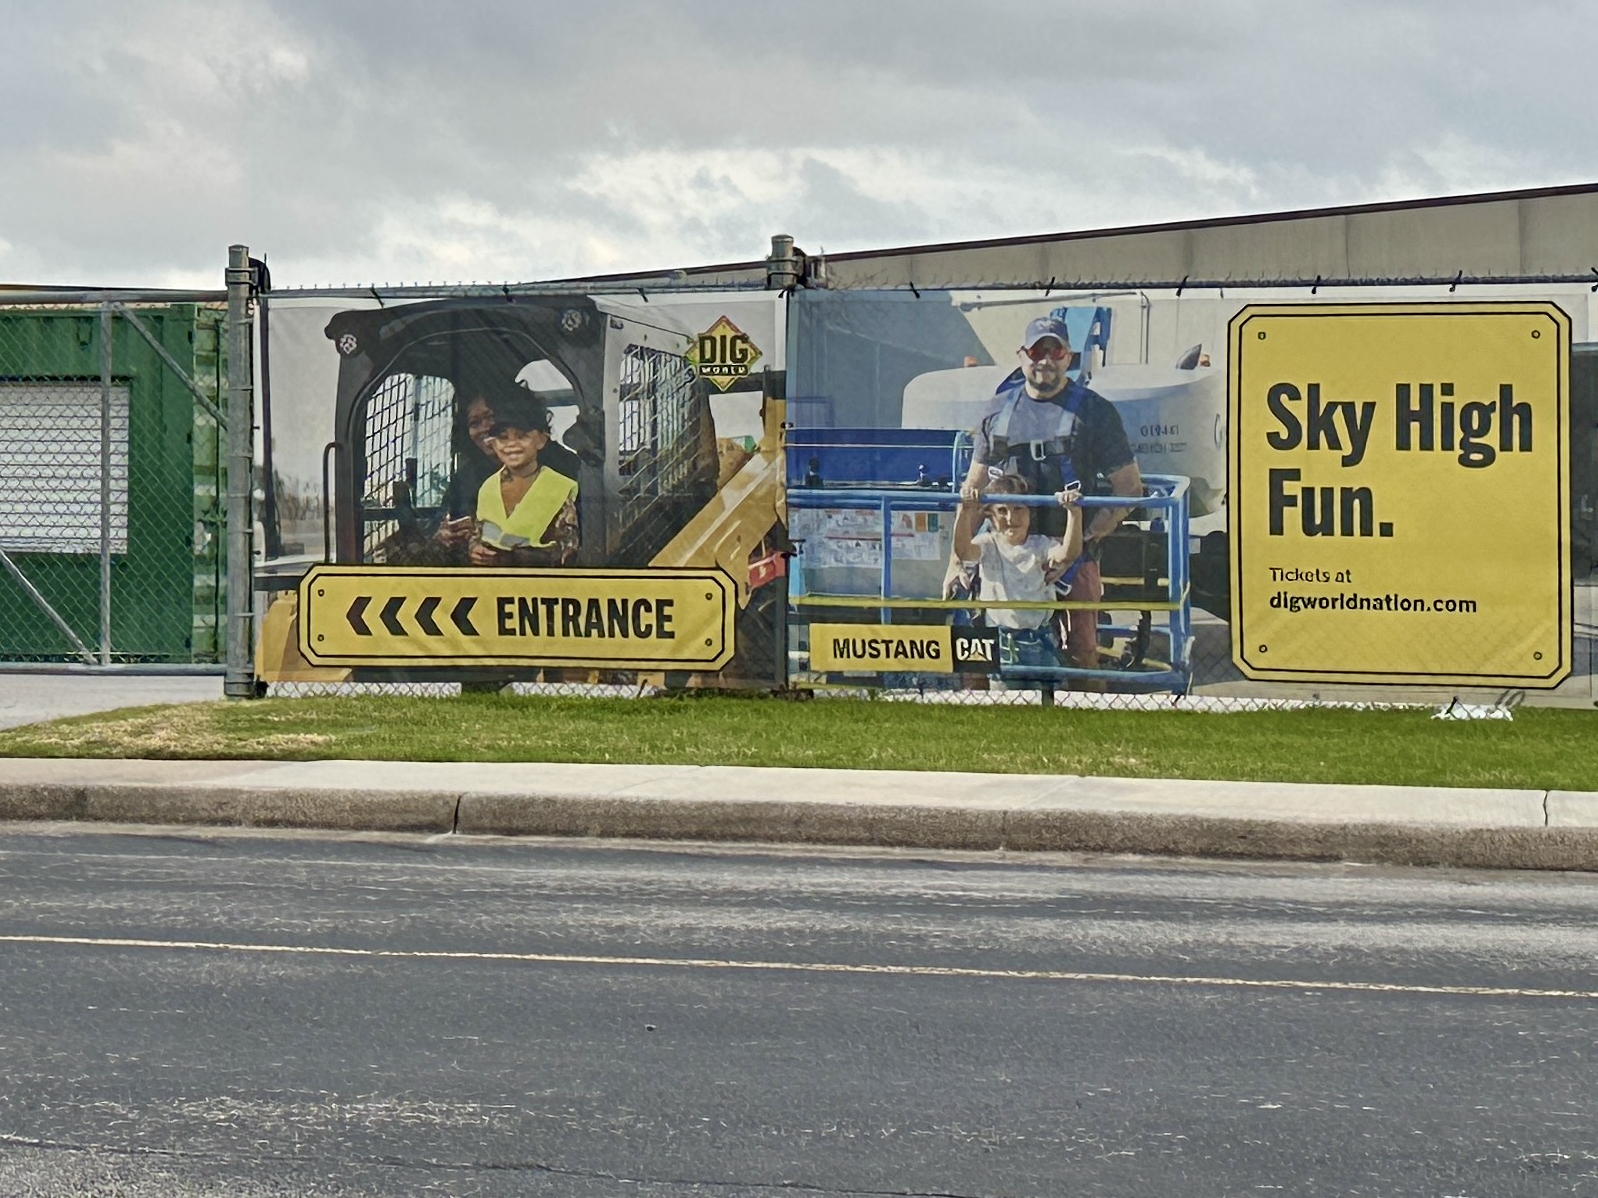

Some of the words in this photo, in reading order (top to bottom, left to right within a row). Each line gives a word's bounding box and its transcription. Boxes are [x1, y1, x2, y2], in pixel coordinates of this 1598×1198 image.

[699, 334, 749, 364] DIG
[1266, 382, 1377, 468] Sky
[1395, 382, 1533, 469] High
[1268, 468, 1394, 538] Fun.
[1269, 567, 1330, 583] Tickets
[1334, 569, 1352, 583] at
[496, 596, 676, 639] ENTRANCE
[1269, 591, 1477, 614] digworldnation.com
[833, 638, 941, 660] MUSTANG
[955, 637, 995, 662] CAT
